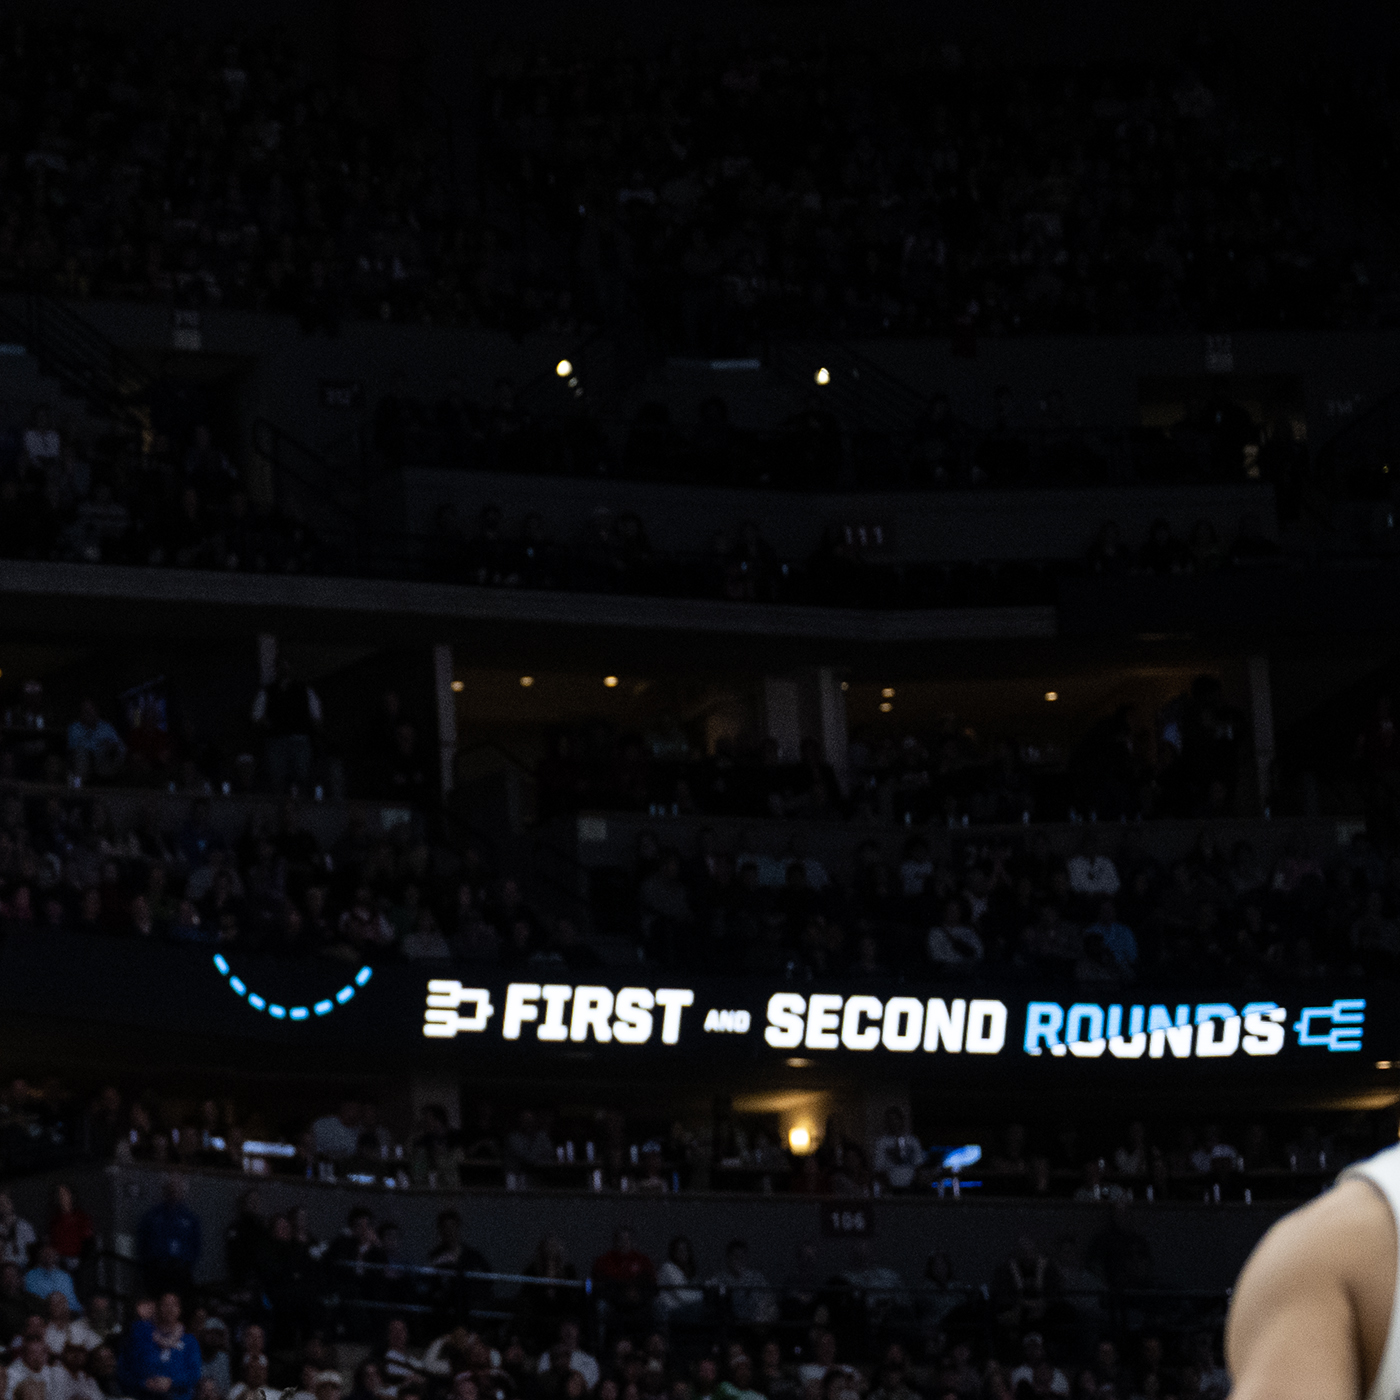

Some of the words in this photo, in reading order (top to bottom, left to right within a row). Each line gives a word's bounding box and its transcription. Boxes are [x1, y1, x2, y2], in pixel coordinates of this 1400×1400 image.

[502, 983, 695, 1044] FIRST
[703, 1009, 751, 1034] AND
[764, 992, 1008, 1054] SECOND
[1023, 1001, 1287, 1058] ROUNDS
